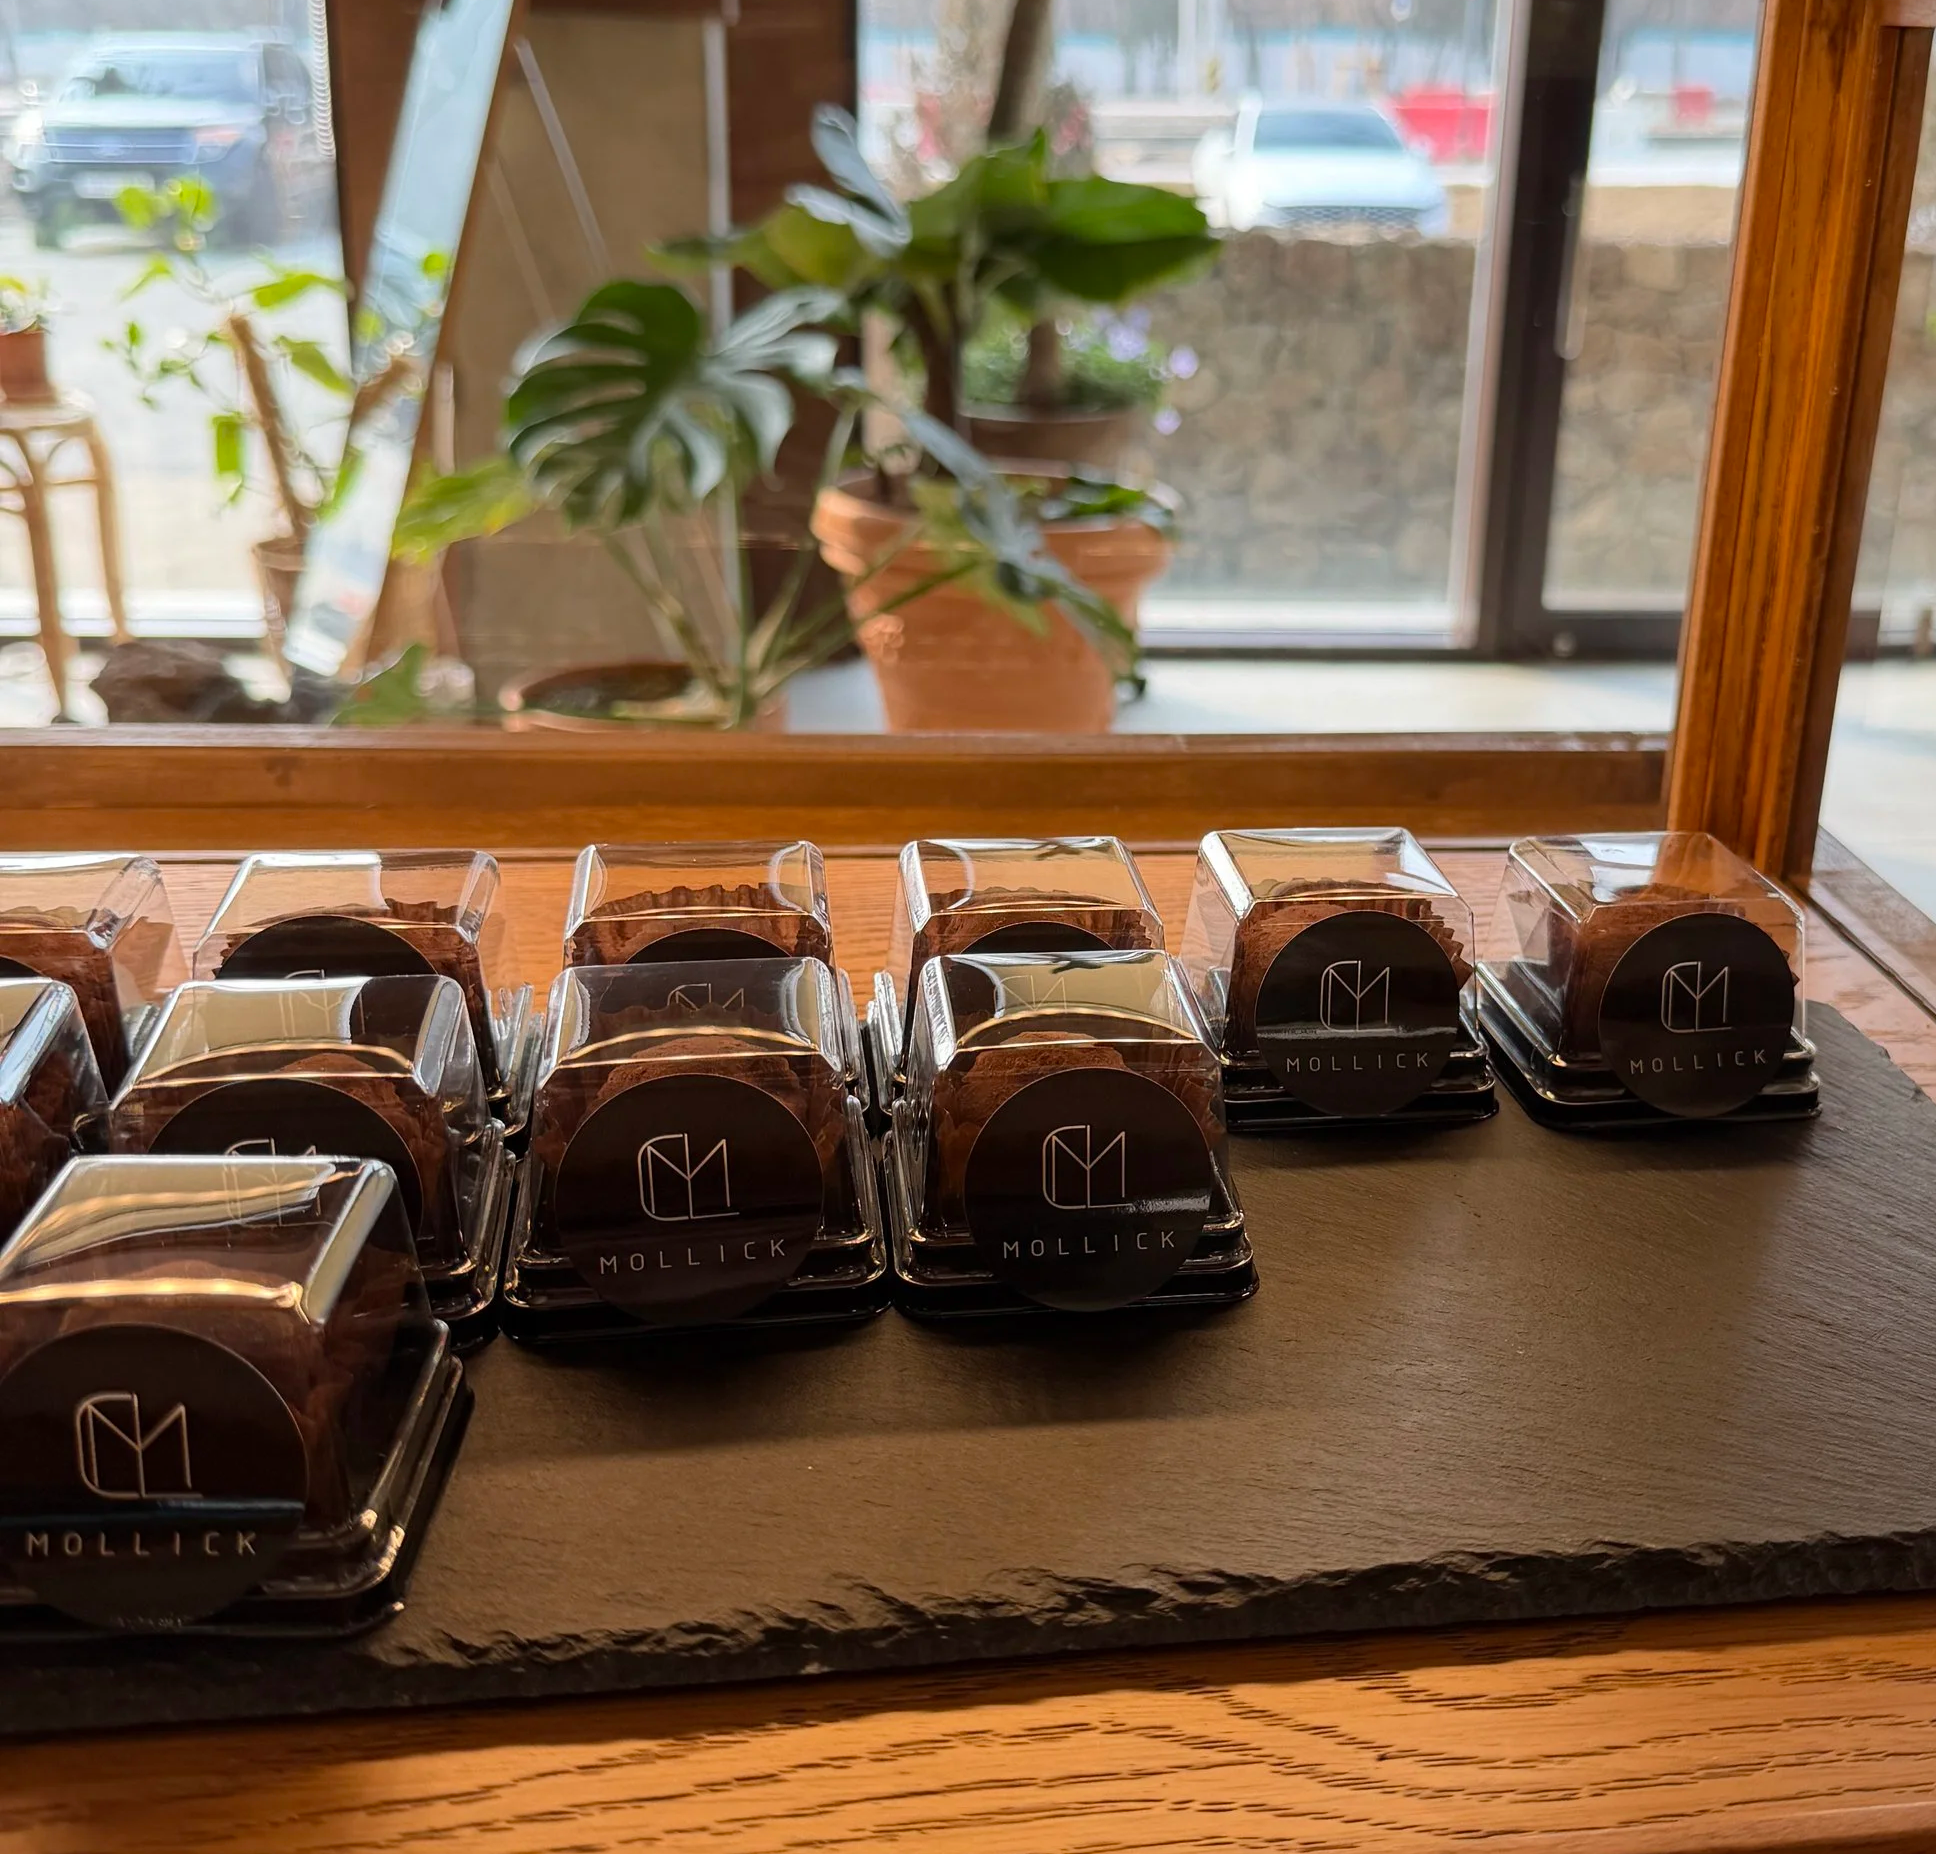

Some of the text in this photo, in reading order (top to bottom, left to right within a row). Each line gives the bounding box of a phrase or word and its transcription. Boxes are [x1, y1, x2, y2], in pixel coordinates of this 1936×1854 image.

[1285, 1051, 1430, 1073] MOLLICK
[1630, 1049, 1768, 1075] MOLLICK
[599, 1239, 787, 1275] MOLLICK
[1003, 1230, 1177, 1259] MOLLICK
[25, 1532, 257, 1557] MOLLICK
